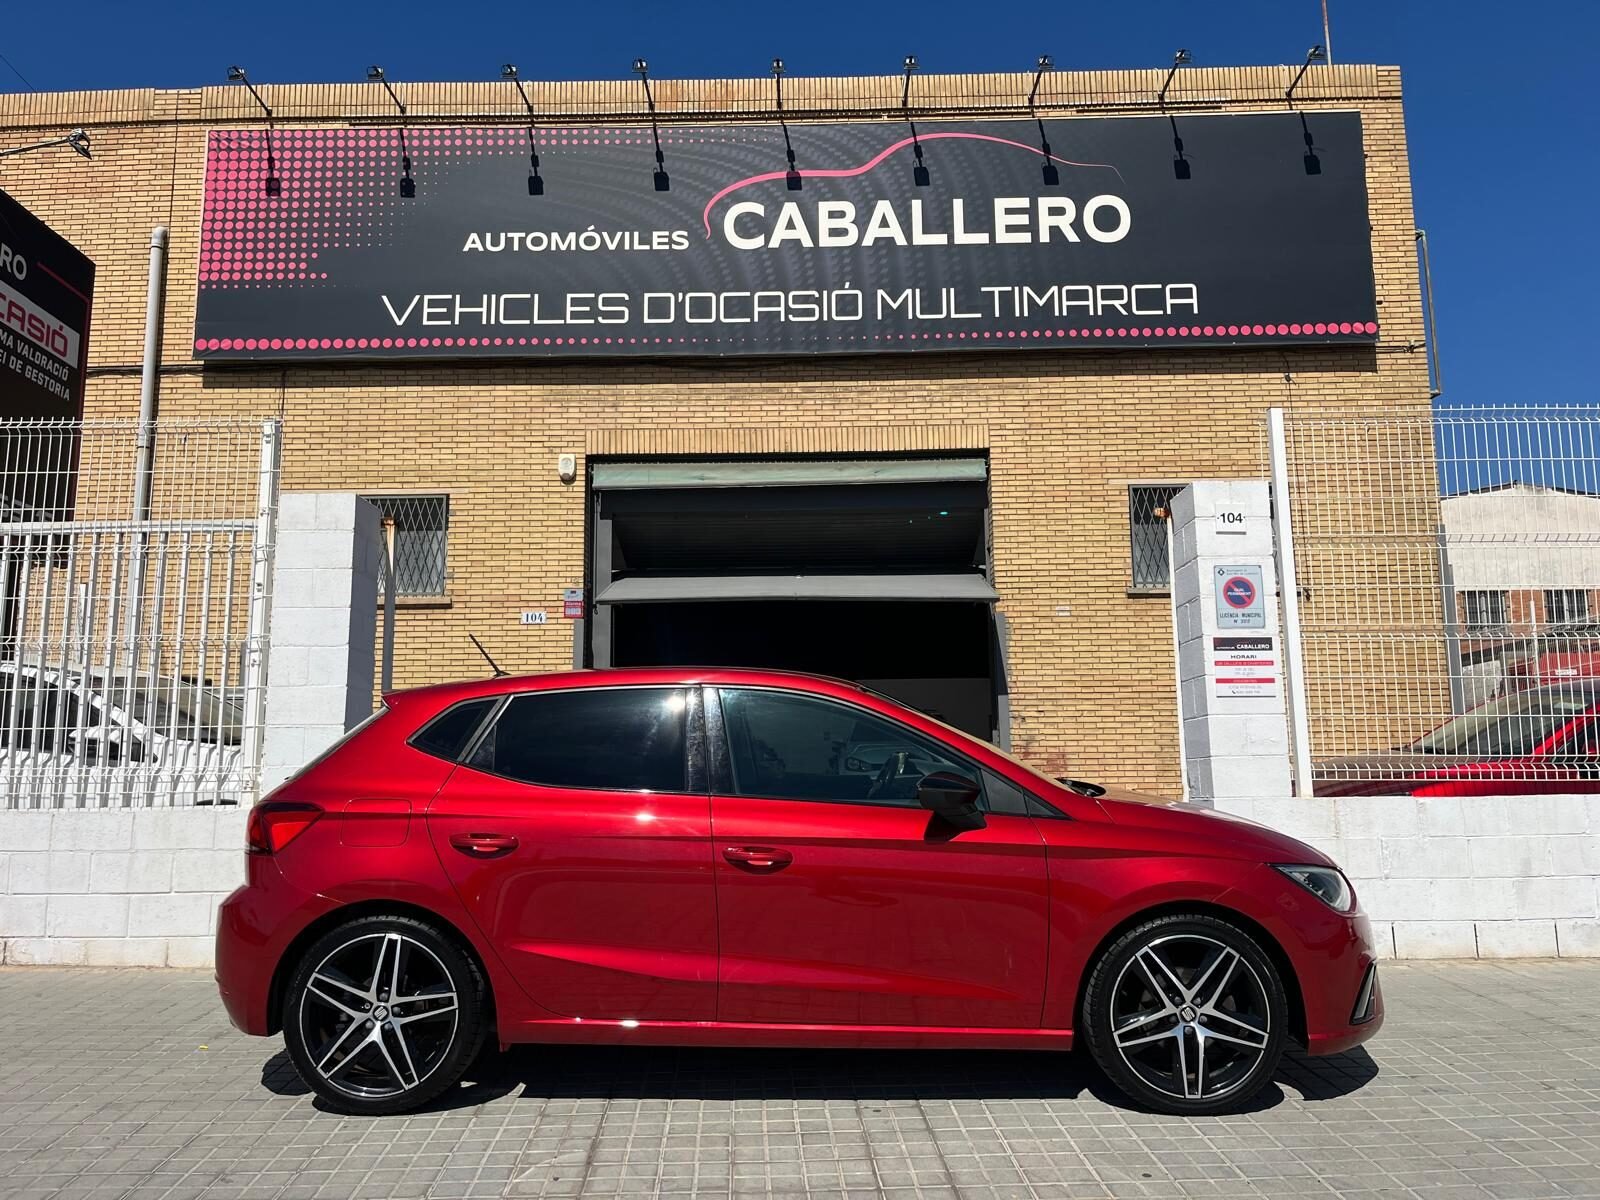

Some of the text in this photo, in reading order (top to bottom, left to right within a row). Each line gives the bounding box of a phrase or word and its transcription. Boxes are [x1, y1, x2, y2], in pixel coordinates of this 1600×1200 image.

[463, 195, 1131, 252] AUTOMÓVILES CABALLERO
[381, 282, 1198, 326] VEHICLES D'OCASIÓ MULTIMARCA
[9, 357, 23, 374] DE
[25, 364, 71, 402] GESTORIA
[17, 339, 70, 382] VALORACIÓ
[525, 613, 543, 623] 104
